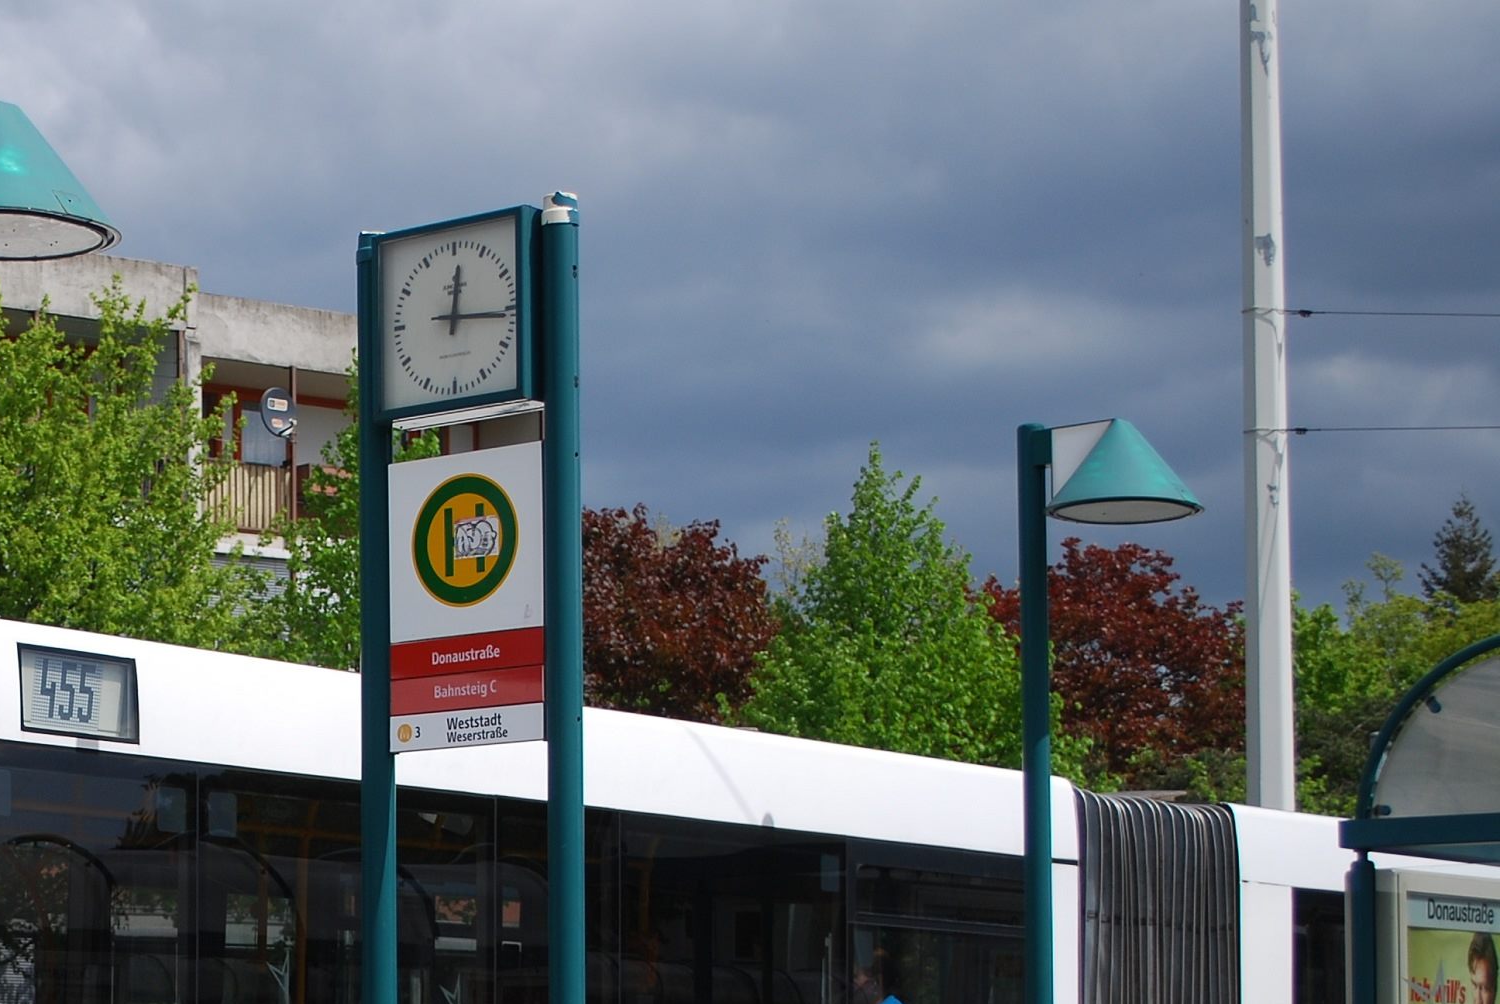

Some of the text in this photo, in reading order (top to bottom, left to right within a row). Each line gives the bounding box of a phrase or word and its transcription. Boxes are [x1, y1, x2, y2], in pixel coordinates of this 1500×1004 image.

[431, 645, 500, 666] Donaustraße
[39, 658, 95, 723] 455
[434, 679, 497, 699] Bahnsteig C
[446, 713, 502, 730] Weststadt
[414, 726, 421, 738] 3
[446, 727, 508, 743] Weserstraße
[1427, 898, 1495, 925] Donaustraße
